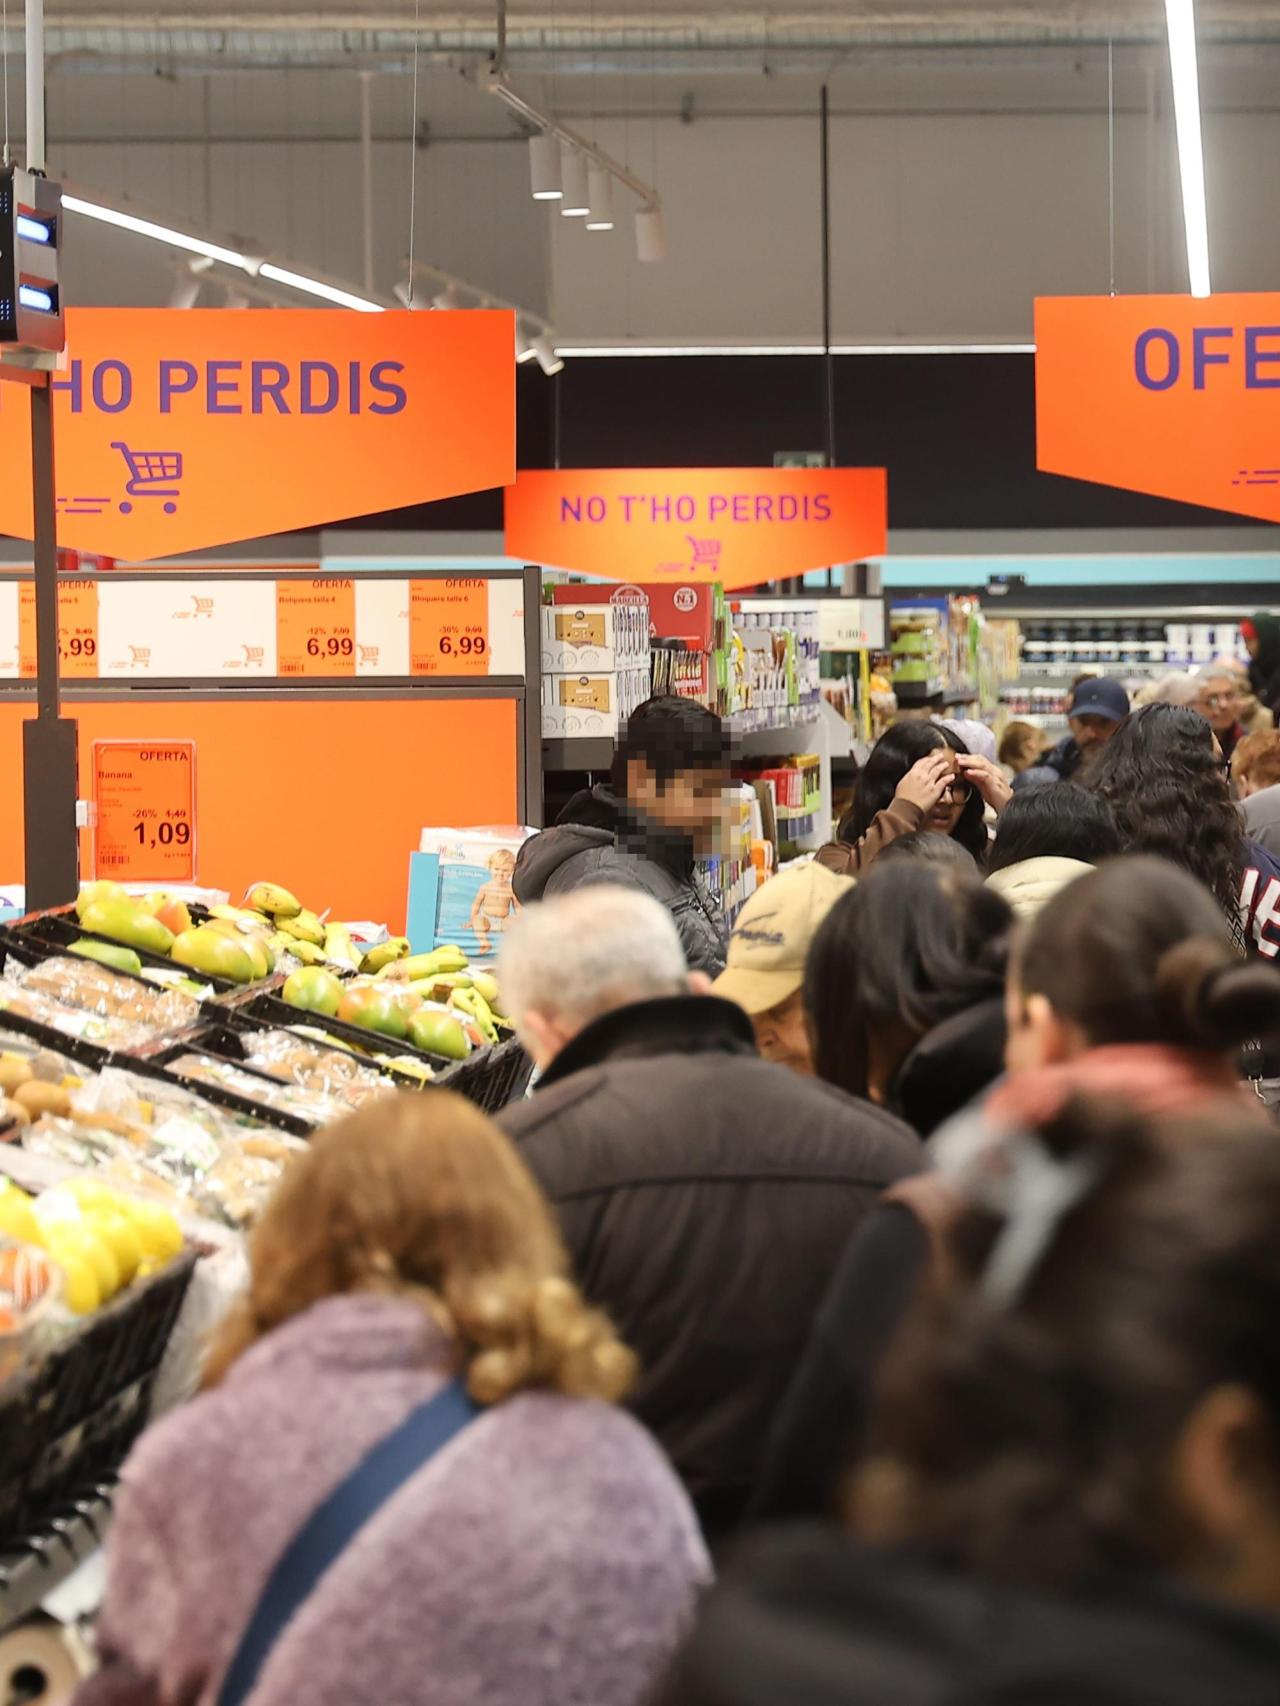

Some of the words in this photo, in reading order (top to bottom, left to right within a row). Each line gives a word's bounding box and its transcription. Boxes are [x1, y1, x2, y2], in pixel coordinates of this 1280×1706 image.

[1134, 326, 1280, 391] OFE
[159, 360, 407, 415] PERDIS
[560, 496, 606, 522] NO
[618, 495, 695, 521] T'HO
[709, 494, 832, 521] PERDIS
[312, 578, 352, 588] OFERTA
[445, 577, 484, 588] OFERTA
[306, 637, 353, 660] 6,99
[439, 636, 486, 659] 6,99
[140, 751, 188, 760] OFERTA
[98, 771, 132, 779] Banana
[132, 809, 157, 818] -26%
[134, 822, 190, 849] 1,09
